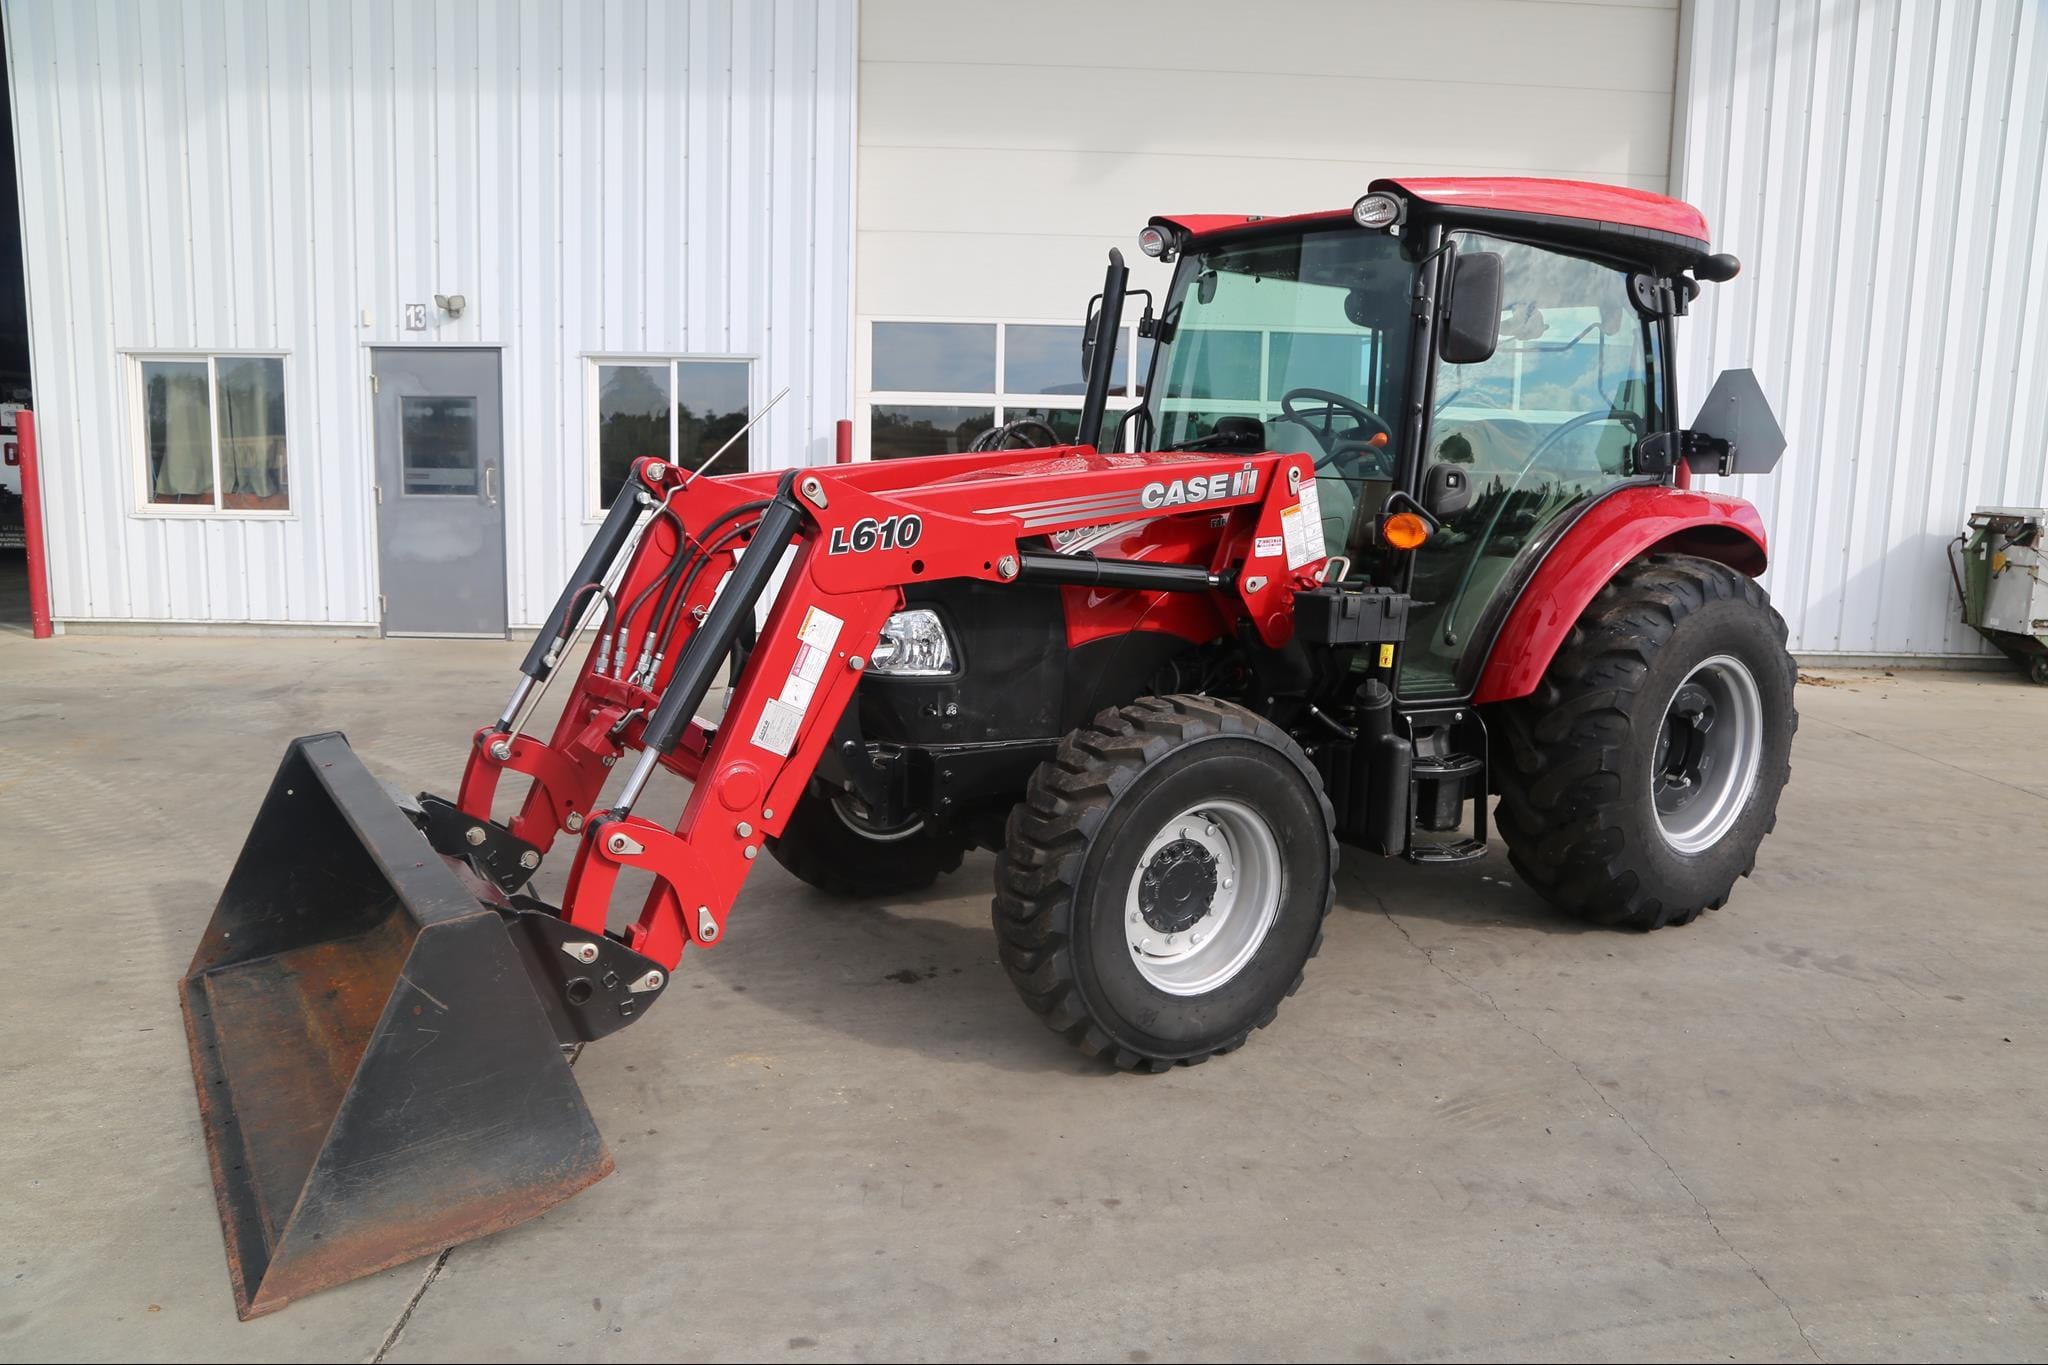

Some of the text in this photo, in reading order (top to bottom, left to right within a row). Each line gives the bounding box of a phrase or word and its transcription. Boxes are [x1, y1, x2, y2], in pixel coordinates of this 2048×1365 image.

[407, 305, 426, 328] 13
[1141, 473, 1229, 509] CASE
[829, 514, 923, 556] L610
